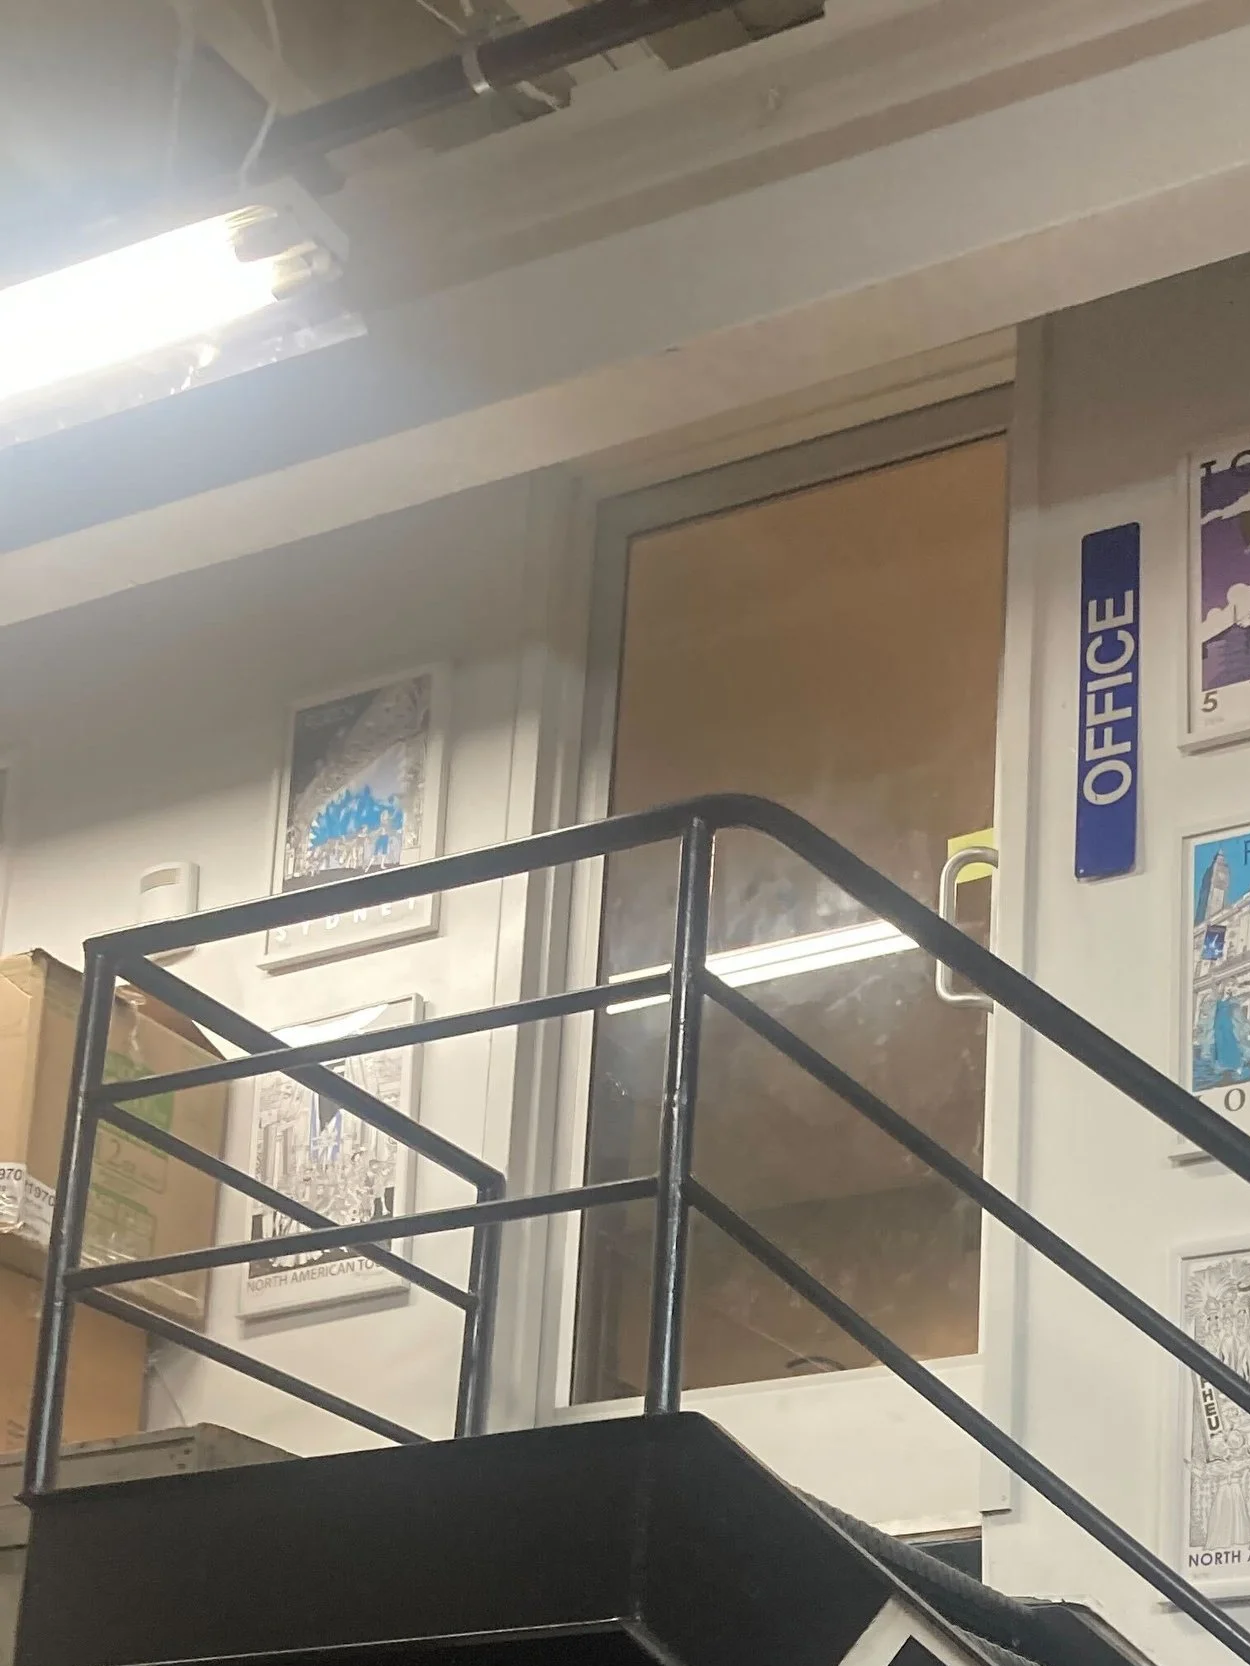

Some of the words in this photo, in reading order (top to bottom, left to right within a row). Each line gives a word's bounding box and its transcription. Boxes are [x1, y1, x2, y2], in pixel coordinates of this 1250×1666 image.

[1083, 589, 1135, 806] OFFICE
[1201, 691, 1219, 713] 5
[246, 1274, 288, 1293] NORTH
[290, 1260, 356, 1284] AMERICAN
[357, 1258, 377, 1271] TO
[1188, 1549, 1241, 1568] NORTH
